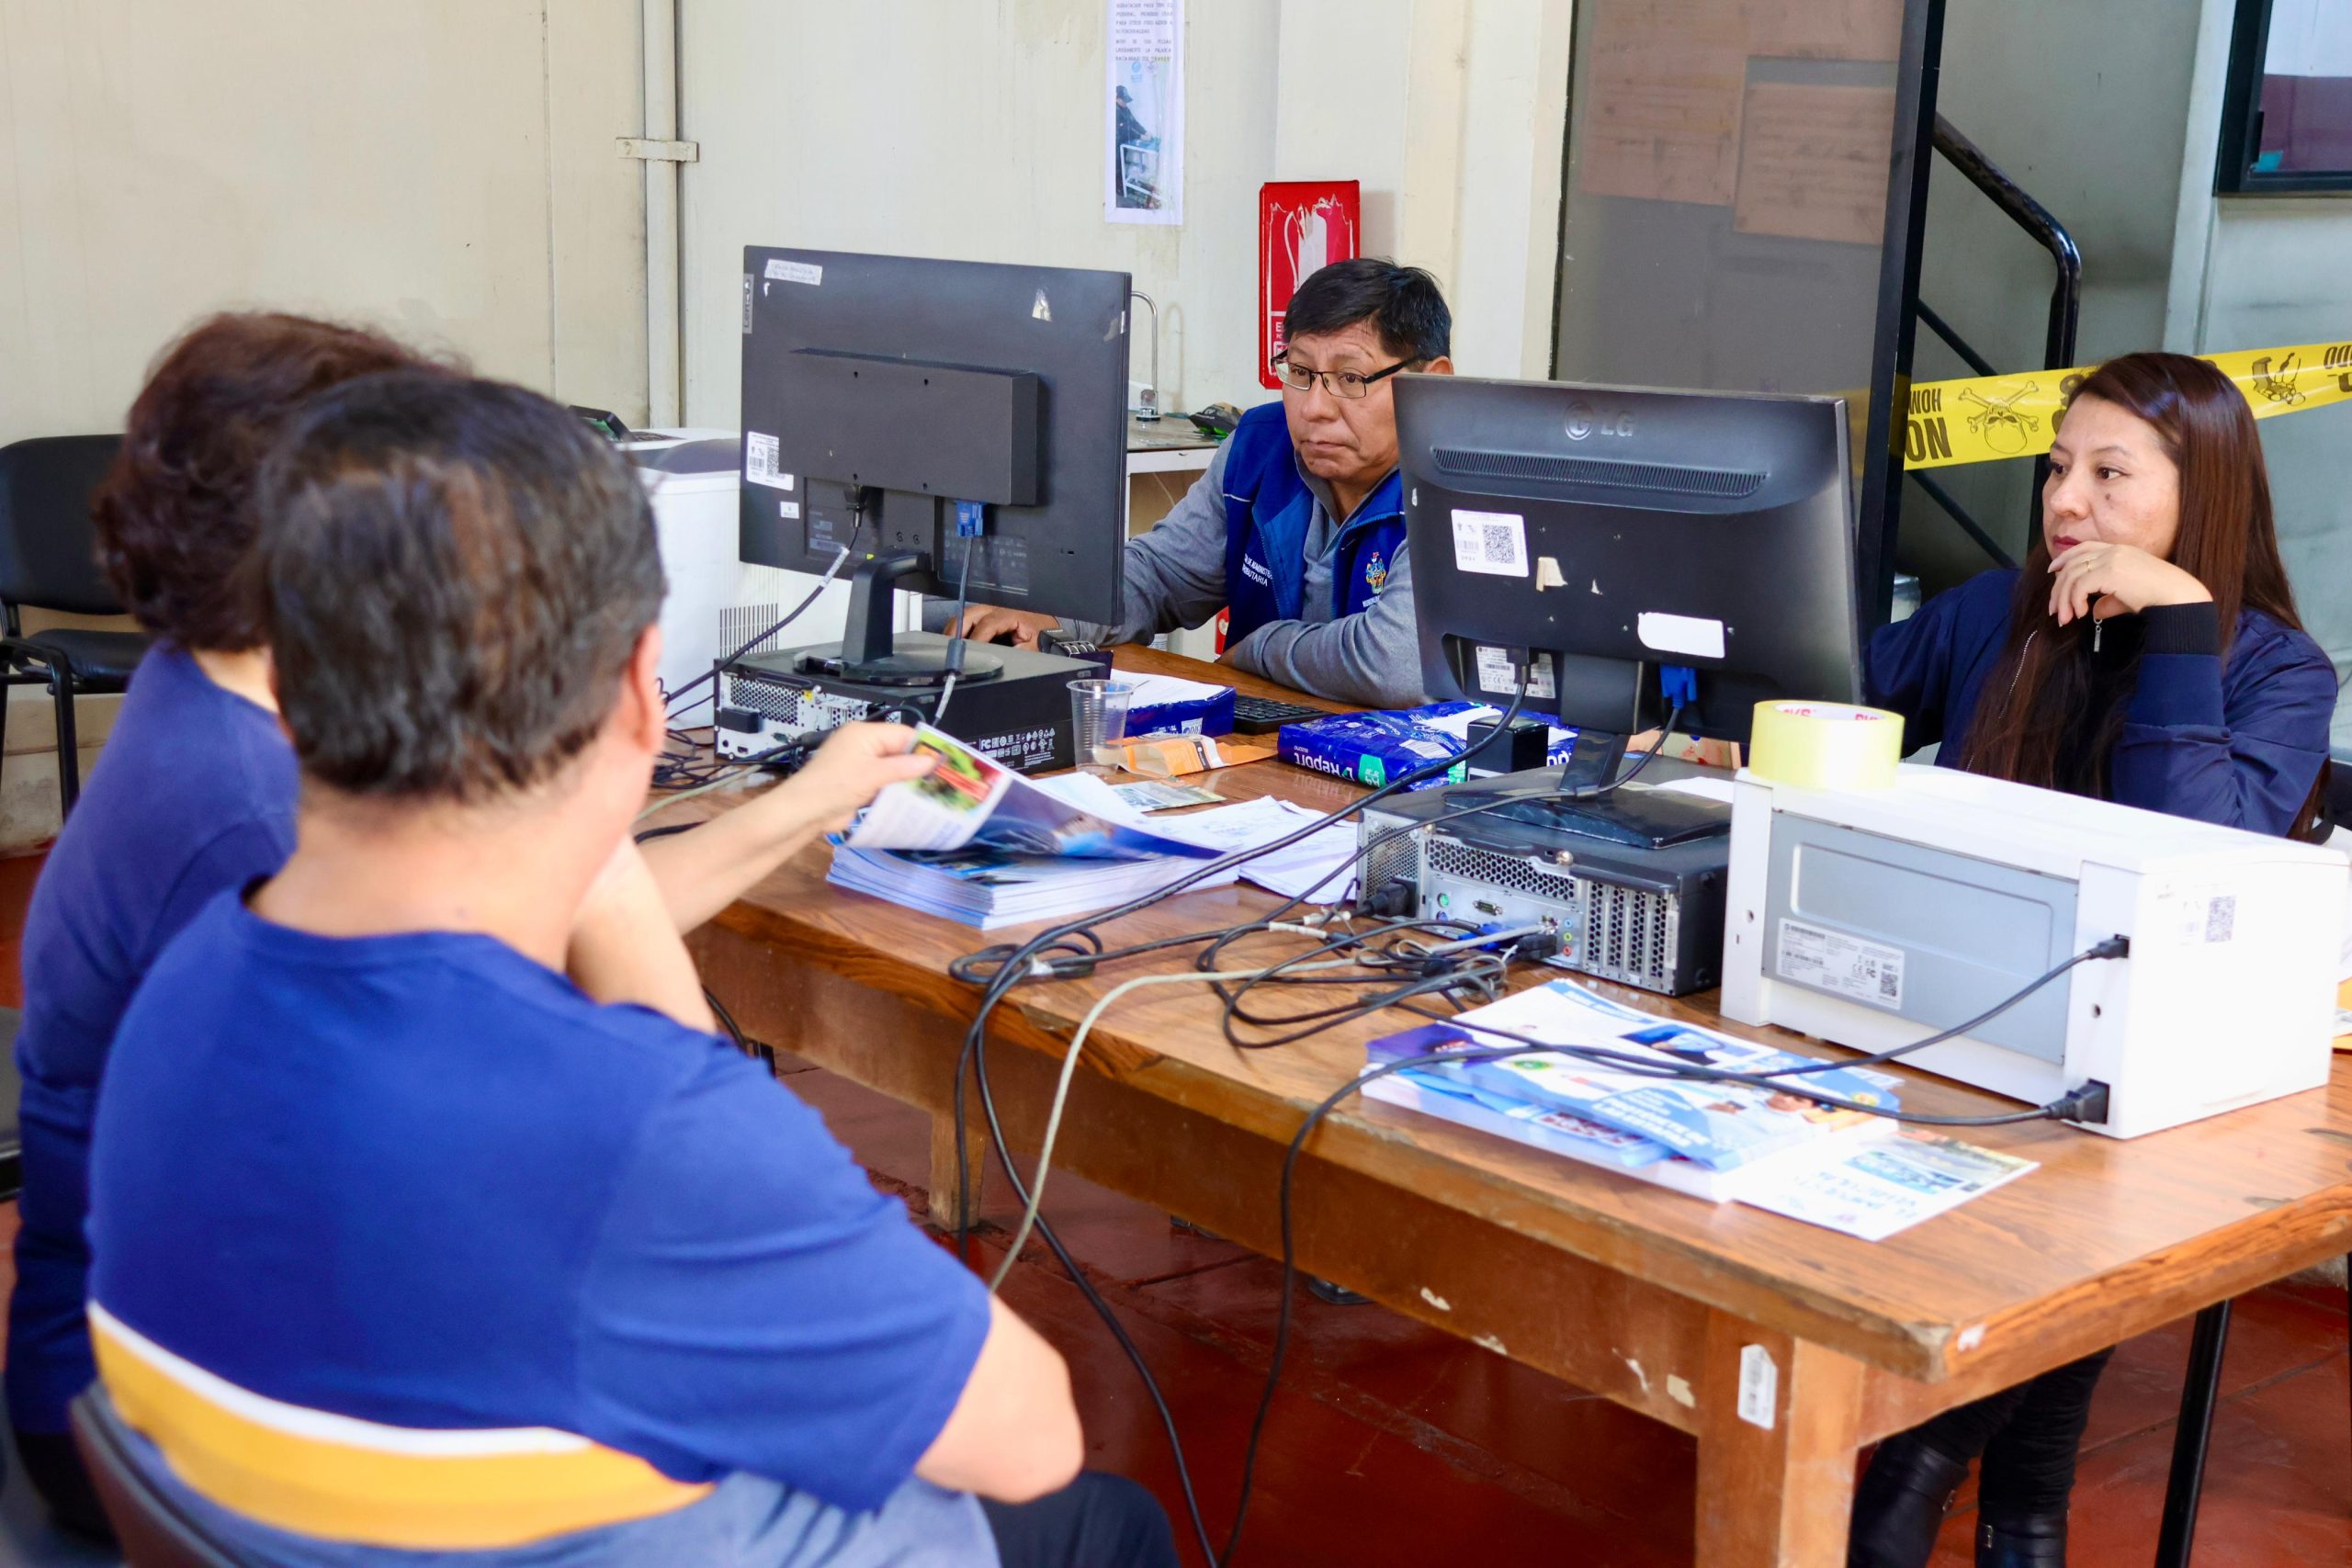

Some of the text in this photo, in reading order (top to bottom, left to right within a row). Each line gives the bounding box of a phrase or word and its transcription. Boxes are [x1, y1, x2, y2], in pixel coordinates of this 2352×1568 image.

[1600, 410, 1634, 436] LG
[1905, 417, 1952, 462] NO
[1294, 752, 1342, 778] Report
